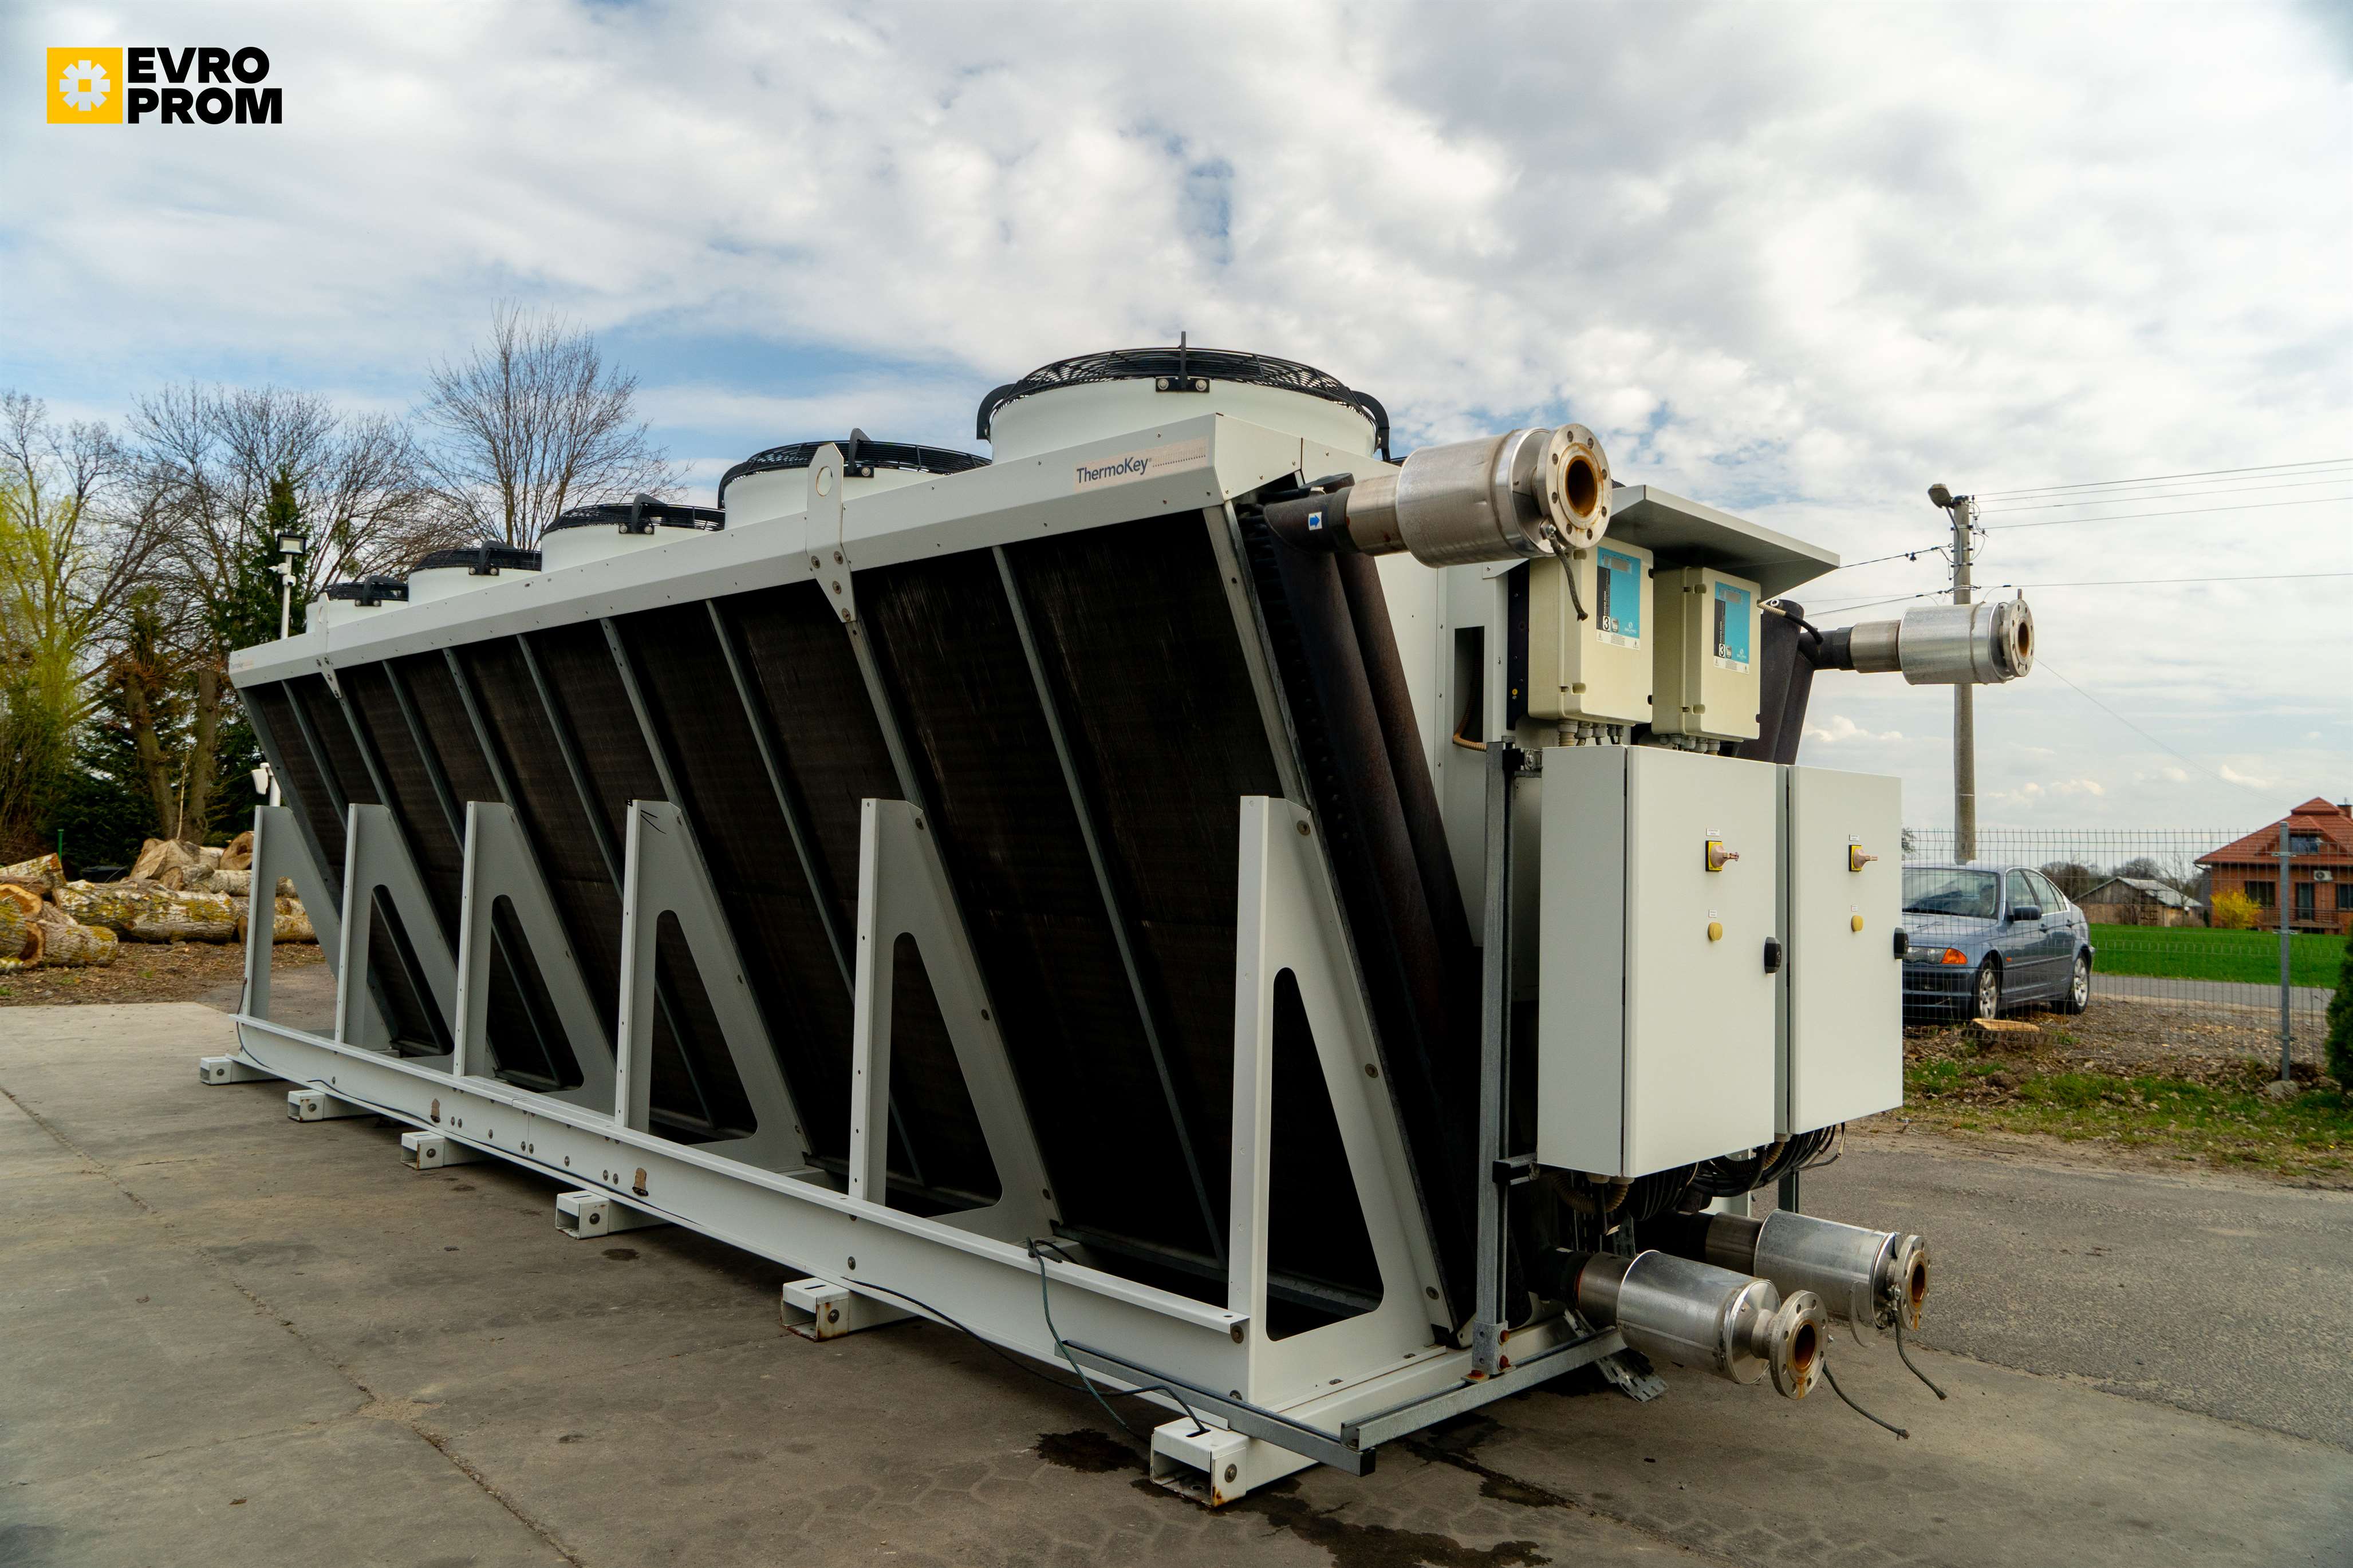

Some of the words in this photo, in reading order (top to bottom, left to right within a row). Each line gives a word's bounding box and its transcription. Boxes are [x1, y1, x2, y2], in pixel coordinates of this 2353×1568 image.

[1077, 457, 1148, 483] ThermoKey
[1604, 617, 1609, 630] 3
[1720, 644, 1724, 656] 3
